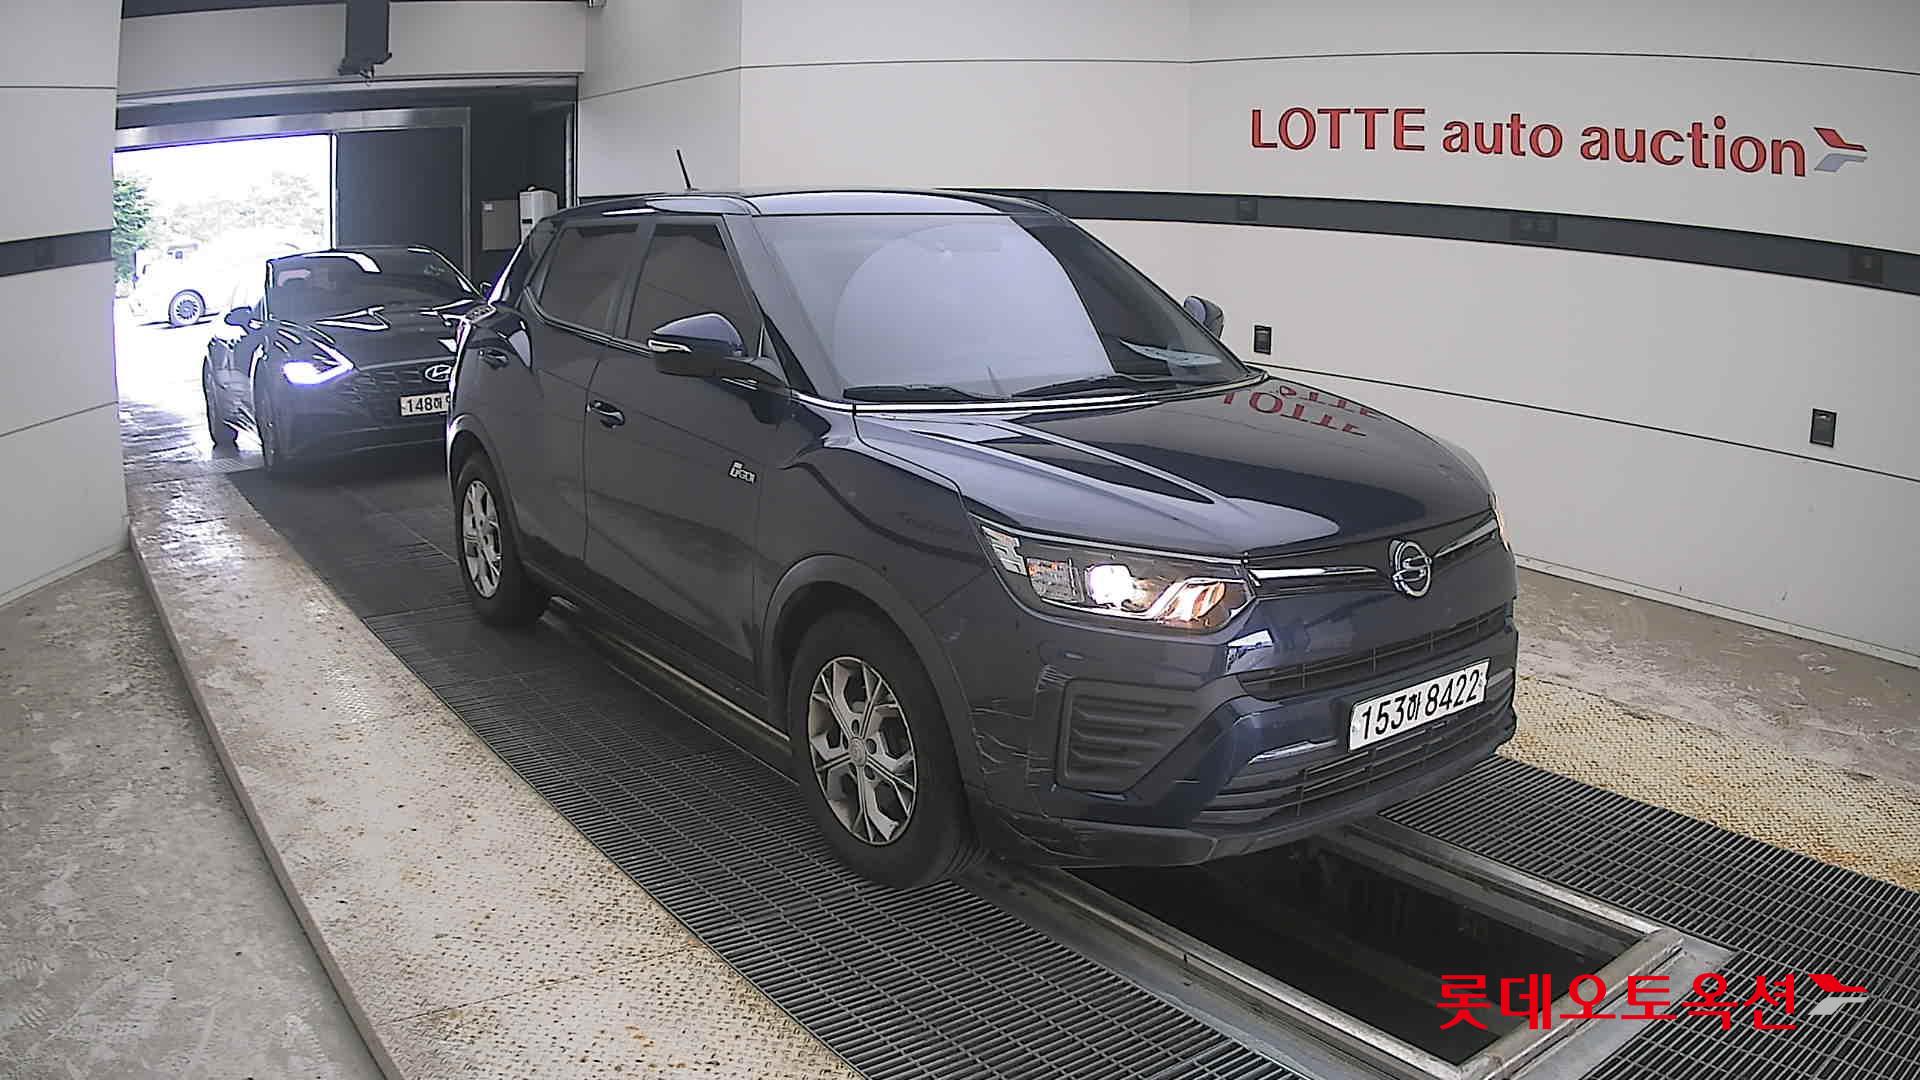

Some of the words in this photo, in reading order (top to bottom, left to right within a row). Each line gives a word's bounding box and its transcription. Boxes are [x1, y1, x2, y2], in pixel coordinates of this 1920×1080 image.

[1251, 108, 1427, 151] LOTTE
[1442, 114, 1564, 158] auto
[1580, 116, 1807, 177] auction
